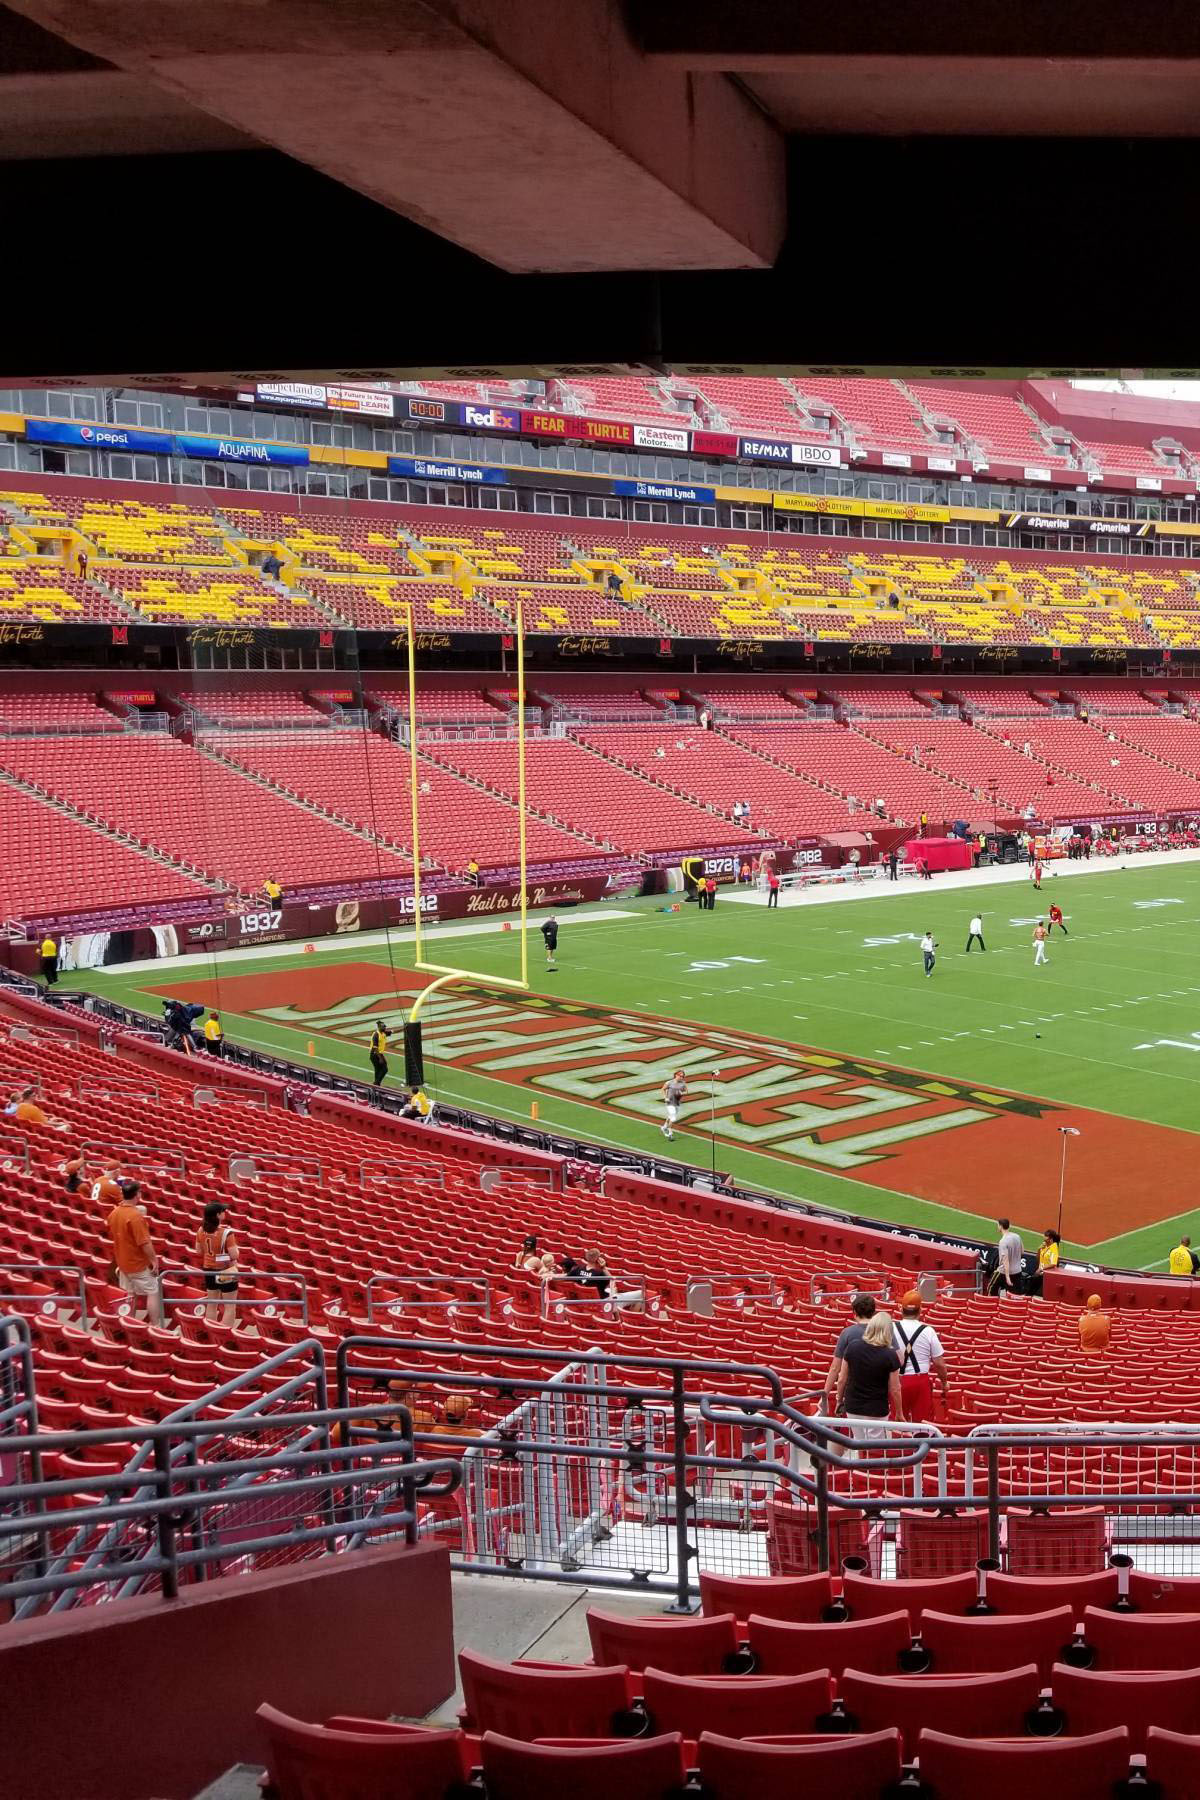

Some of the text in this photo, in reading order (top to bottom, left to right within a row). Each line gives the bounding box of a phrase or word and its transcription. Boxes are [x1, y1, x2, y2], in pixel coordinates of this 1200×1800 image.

[361, 401, 390, 411] LEARN
[465, 406, 513, 429] FedEx
[96, 432, 128, 444] pepsi
[646, 429, 684, 442] Eastern
[744, 442, 789, 459] RE/MAX
[803, 447, 832, 462] BDO
[427, 464, 483, 480] Merrill Lynch
[647, 485, 696, 500] Merrill Lynch
[785, 498, 852, 512] MARYLAND LOTTERY
[875, 507, 939, 519] MARYLAND LOTTERY
[704, 858, 734, 873] 1972
[466, 895, 496, 912] Hail
[497, 899, 510, 909] to
[239, 911, 283, 934] 1937
